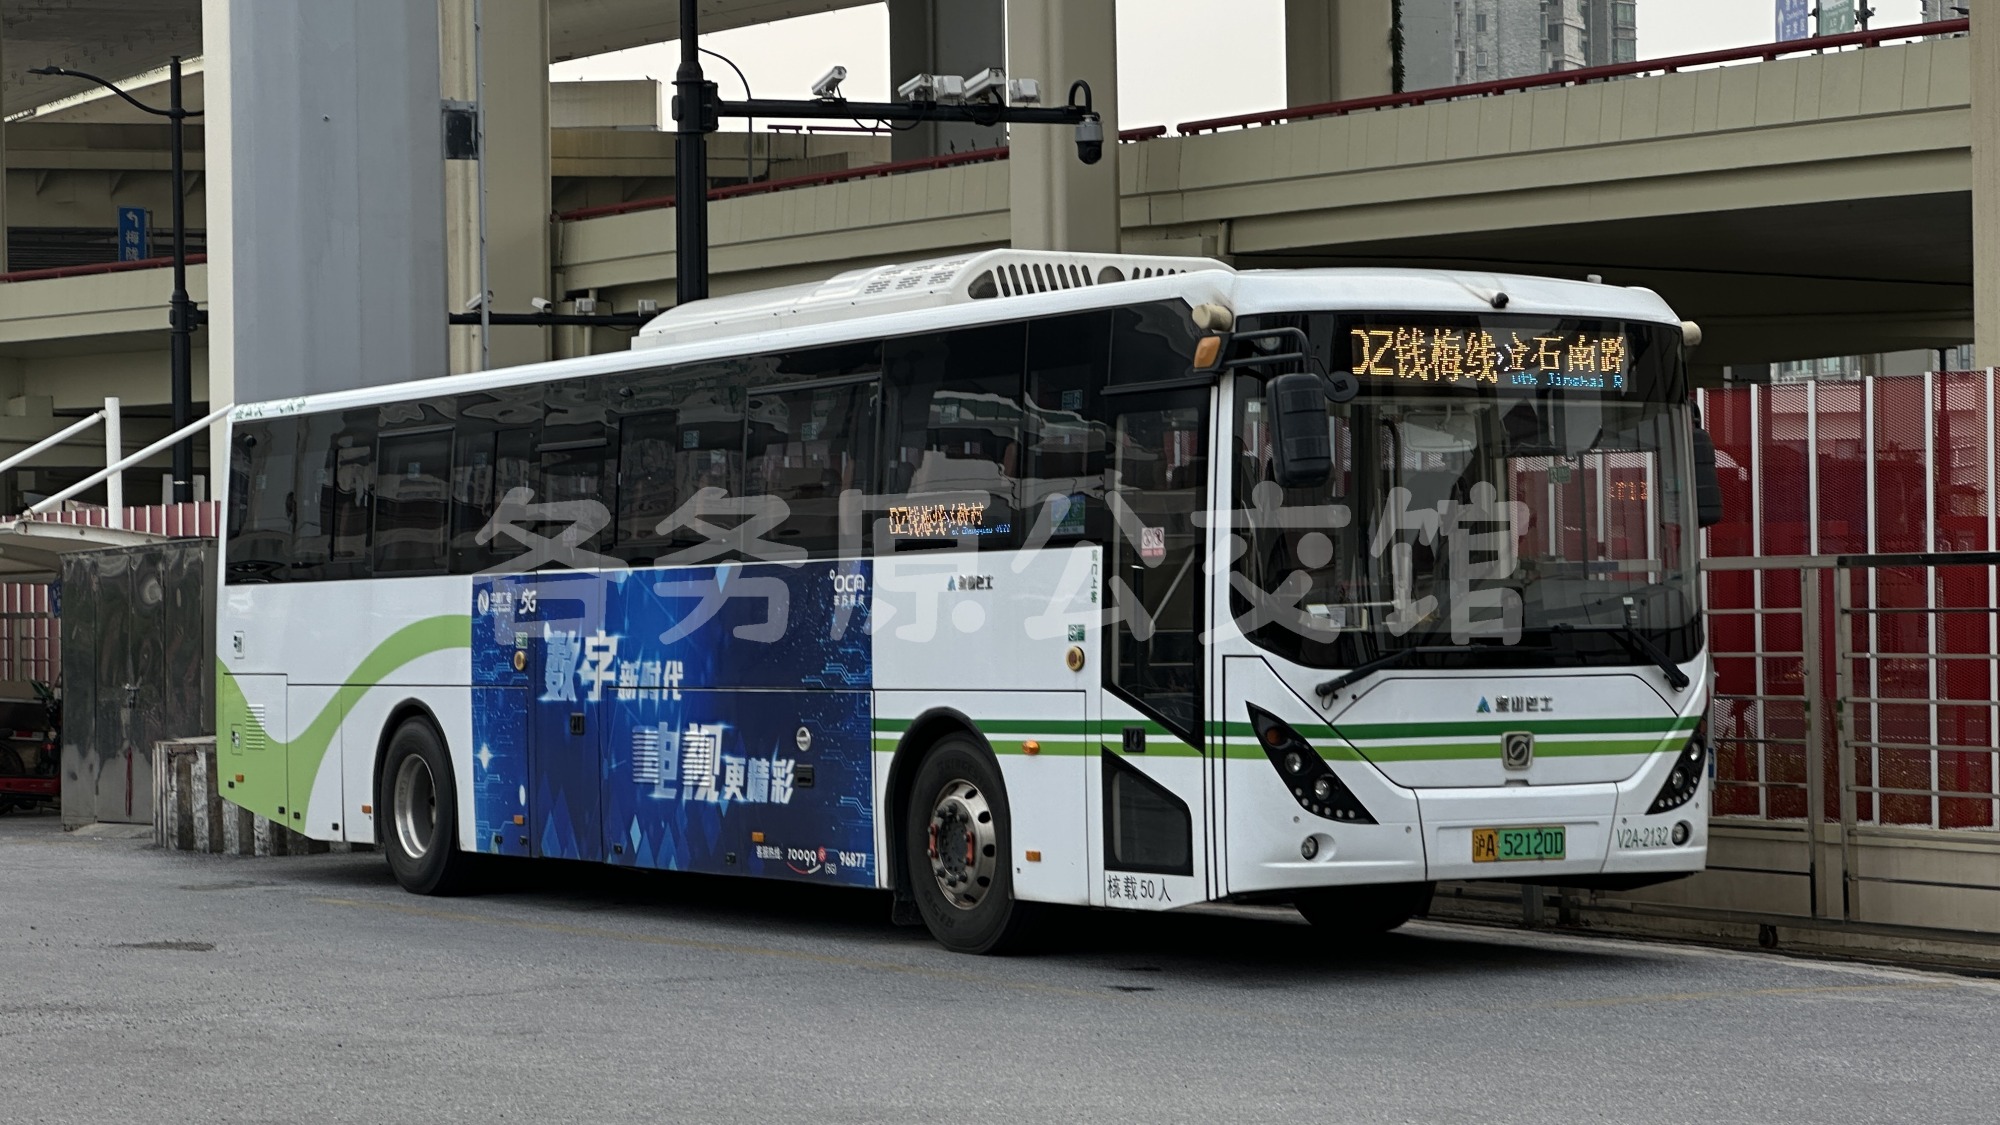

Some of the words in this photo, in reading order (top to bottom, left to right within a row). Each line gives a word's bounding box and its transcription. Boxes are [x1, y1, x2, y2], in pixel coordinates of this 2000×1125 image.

[519, 588, 537, 614] 5G
[1495, 695, 1553, 713] 宝山巴士
[1617, 826, 1669, 848] V2A-2132
[787, 848, 817, 867] 10099
[839, 850, 867, 868] 96877
